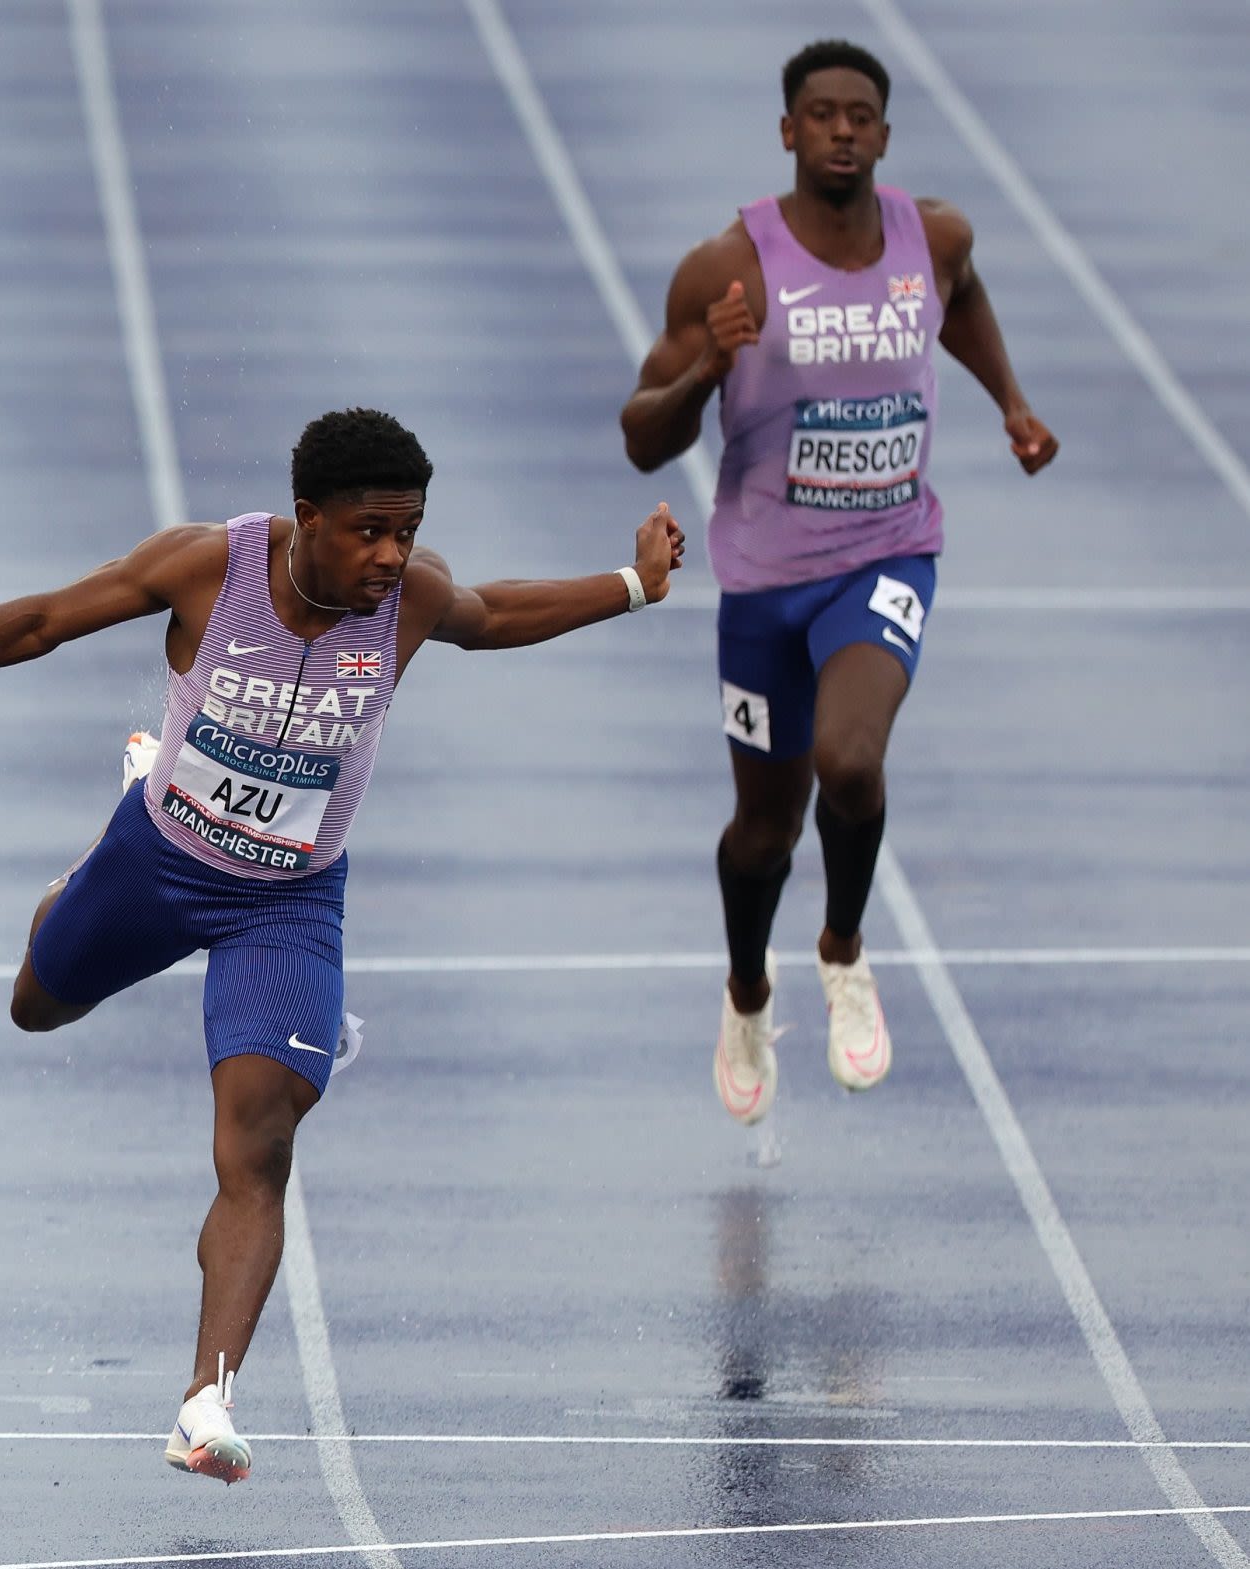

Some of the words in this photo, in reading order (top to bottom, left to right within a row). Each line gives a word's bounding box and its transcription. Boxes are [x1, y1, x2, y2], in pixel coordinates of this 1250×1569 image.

[788, 300, 924, 336] GREAT
[788, 329, 926, 365] BRITAIN
[797, 433, 917, 472] PRESCOD
[793, 482, 913, 509] MANCHESTER
[889, 596, 913, 619] 4
[208, 667, 376, 718] GREAT
[202, 693, 369, 747] BRITAIN
[734, 701, 757, 735] 4
[195, 738, 216, 755] DATA
[218, 753, 276, 778] PROCESSING
[291, 776, 323, 785] TIMING
[210, 777, 284, 824] AZU
[168, 799, 298, 870] MANCHESTER
[230, 822, 303, 849] CHAMPIONSHIPS
